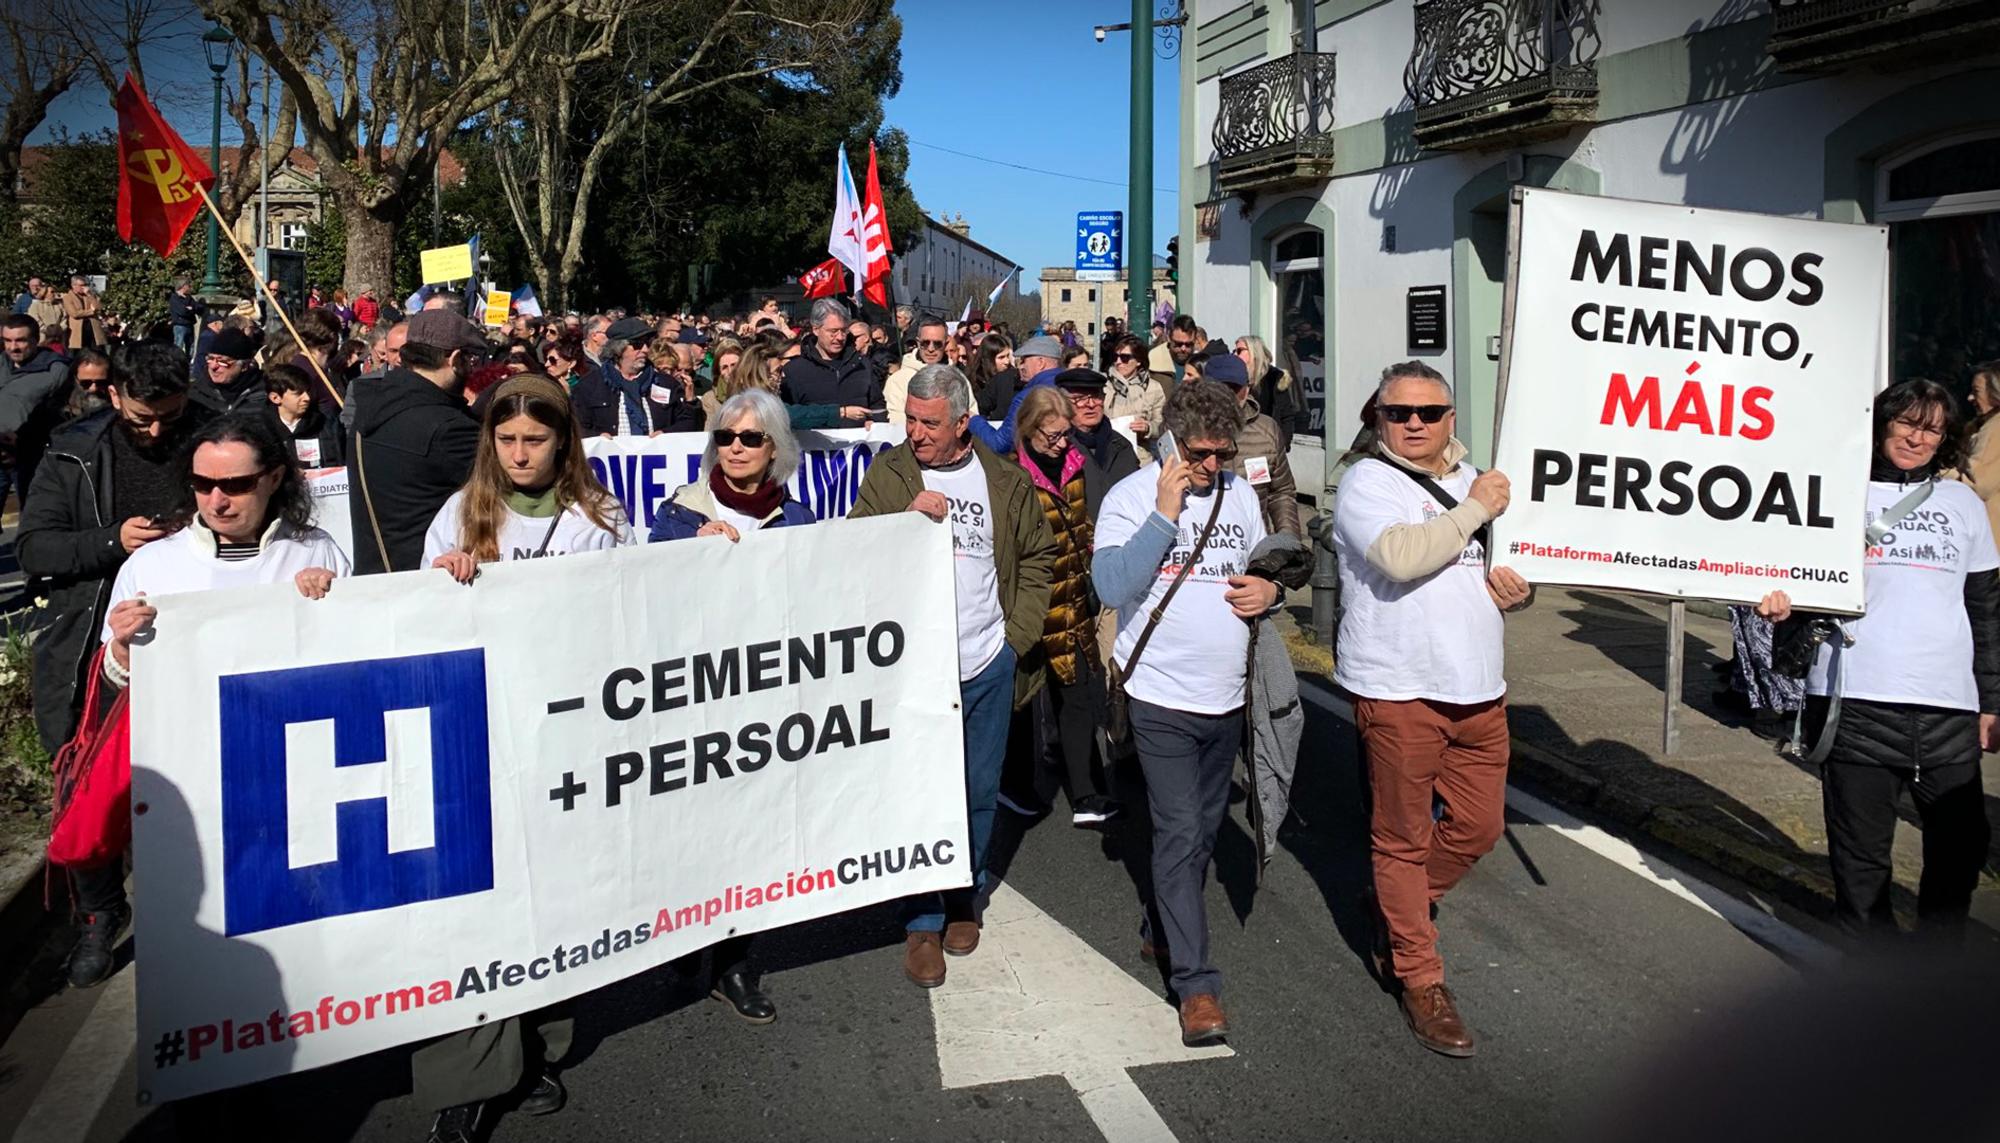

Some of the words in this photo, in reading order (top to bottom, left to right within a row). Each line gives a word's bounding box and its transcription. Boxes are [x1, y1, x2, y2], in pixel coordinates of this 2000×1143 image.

[1570, 229, 1825, 307] MENOS
[1571, 302, 1814, 369] CEMENTO,
[1600, 361, 1775, 441] MÁIS
[1531, 448, 1834, 529] PERSOAL
[1882, 507, 1949, 525] OVO
[1509, 542, 1850, 583] #PlataformaAfectadasAmpliaciónCHUAC
[601, 620, 906, 721] CEMENTO
[285, 706, 435, 870] H
[605, 699, 890, 808] PERSOAL
[153, 839, 956, 1069] #PlataformaAfectadasAmpliaciónCHUAC
